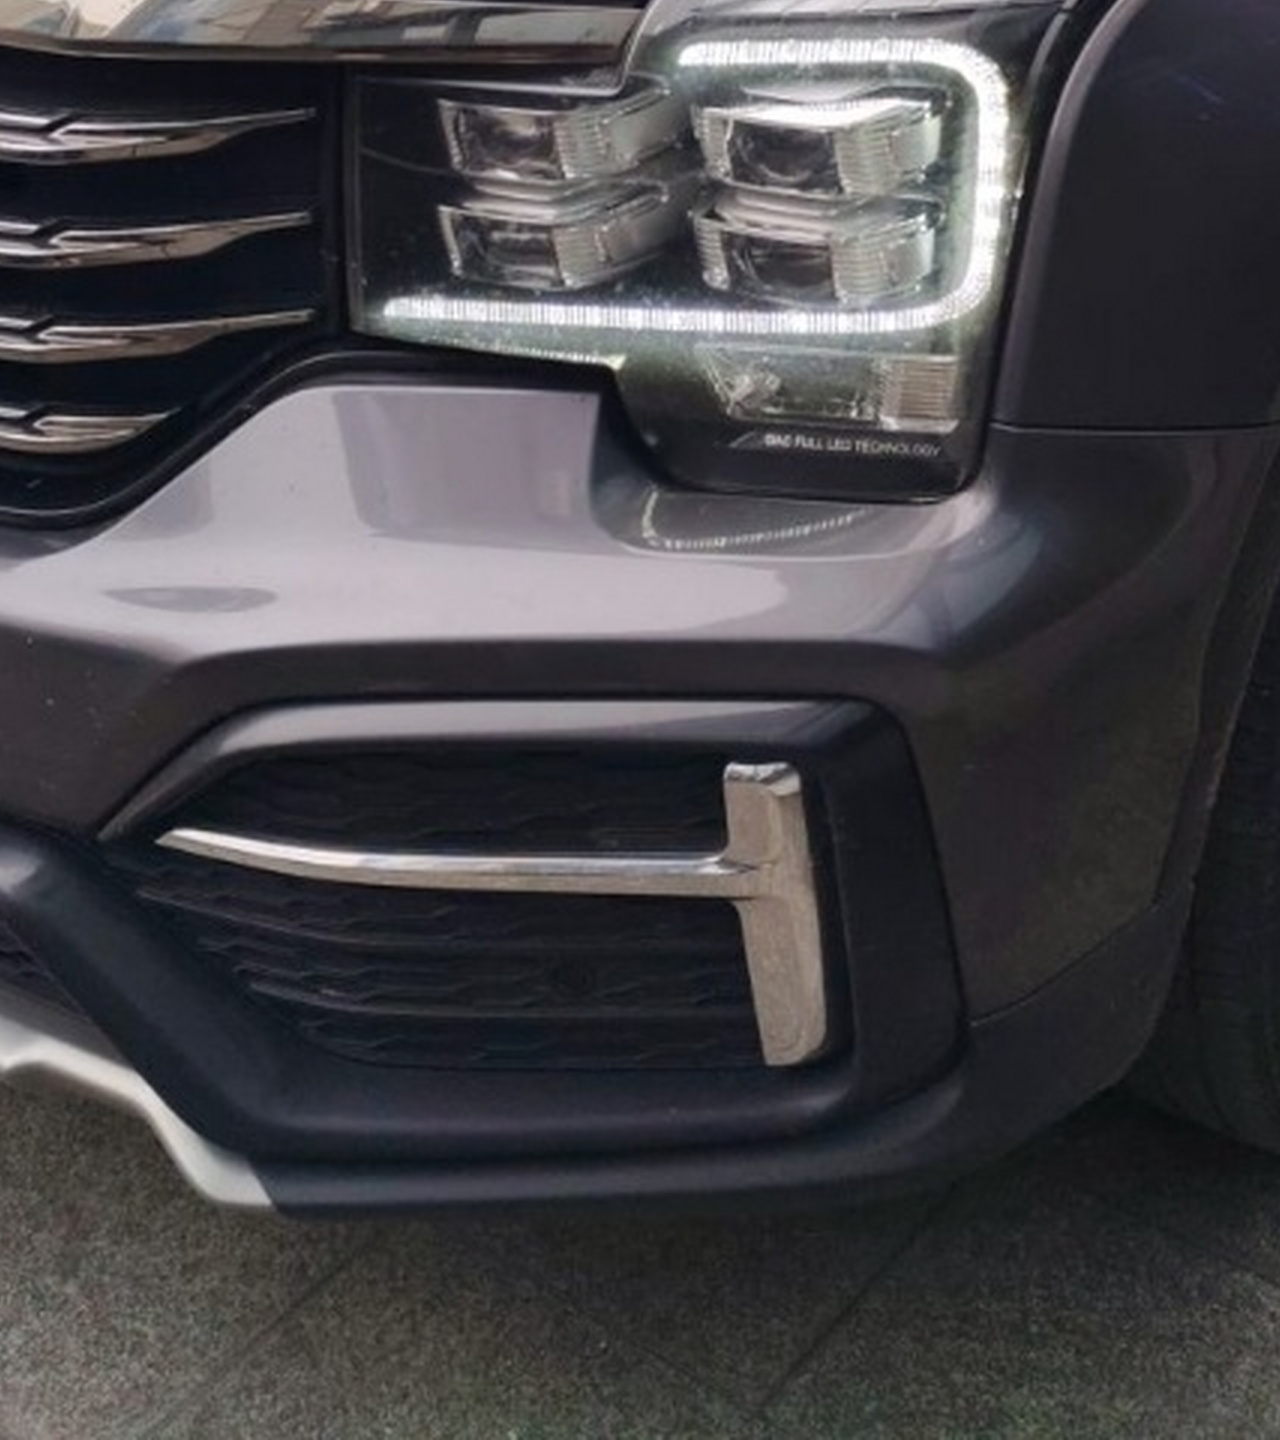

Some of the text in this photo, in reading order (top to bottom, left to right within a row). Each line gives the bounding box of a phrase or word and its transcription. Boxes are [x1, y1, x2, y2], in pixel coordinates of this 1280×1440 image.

[794, 434, 823, 451] FULL
[827, 436, 852, 452] LED
[854, 438, 942, 458] TECHNOLOGY
